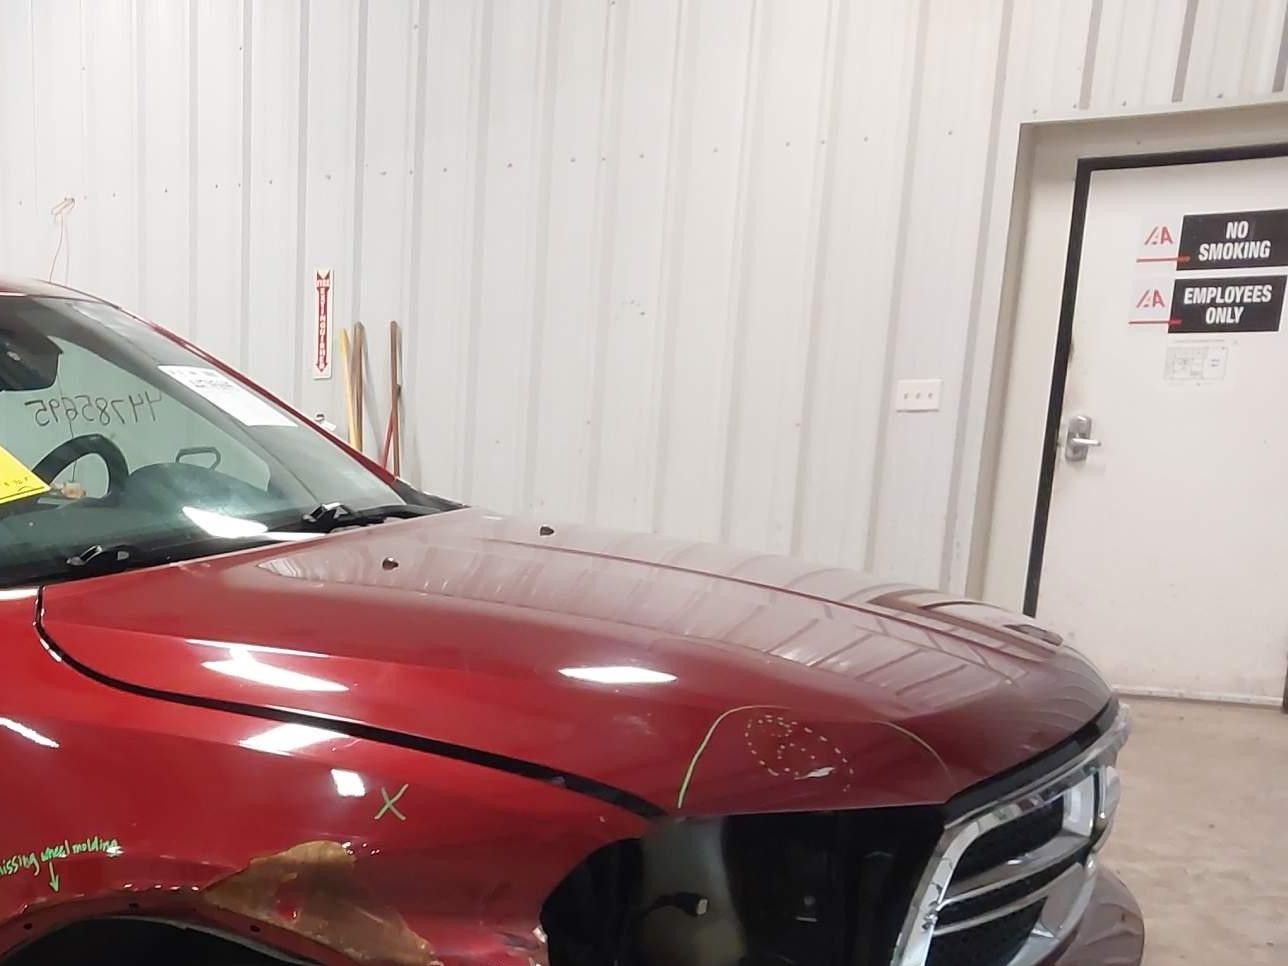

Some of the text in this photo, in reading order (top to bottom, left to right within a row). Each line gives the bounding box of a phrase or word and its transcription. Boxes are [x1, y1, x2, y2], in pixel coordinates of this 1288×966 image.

[1226, 221, 1249, 239] NO
[1198, 240, 1271, 262] SMOKING
[1184, 285, 1273, 305] EMPLOYEES
[1205, 306, 1245, 324] ONLY
